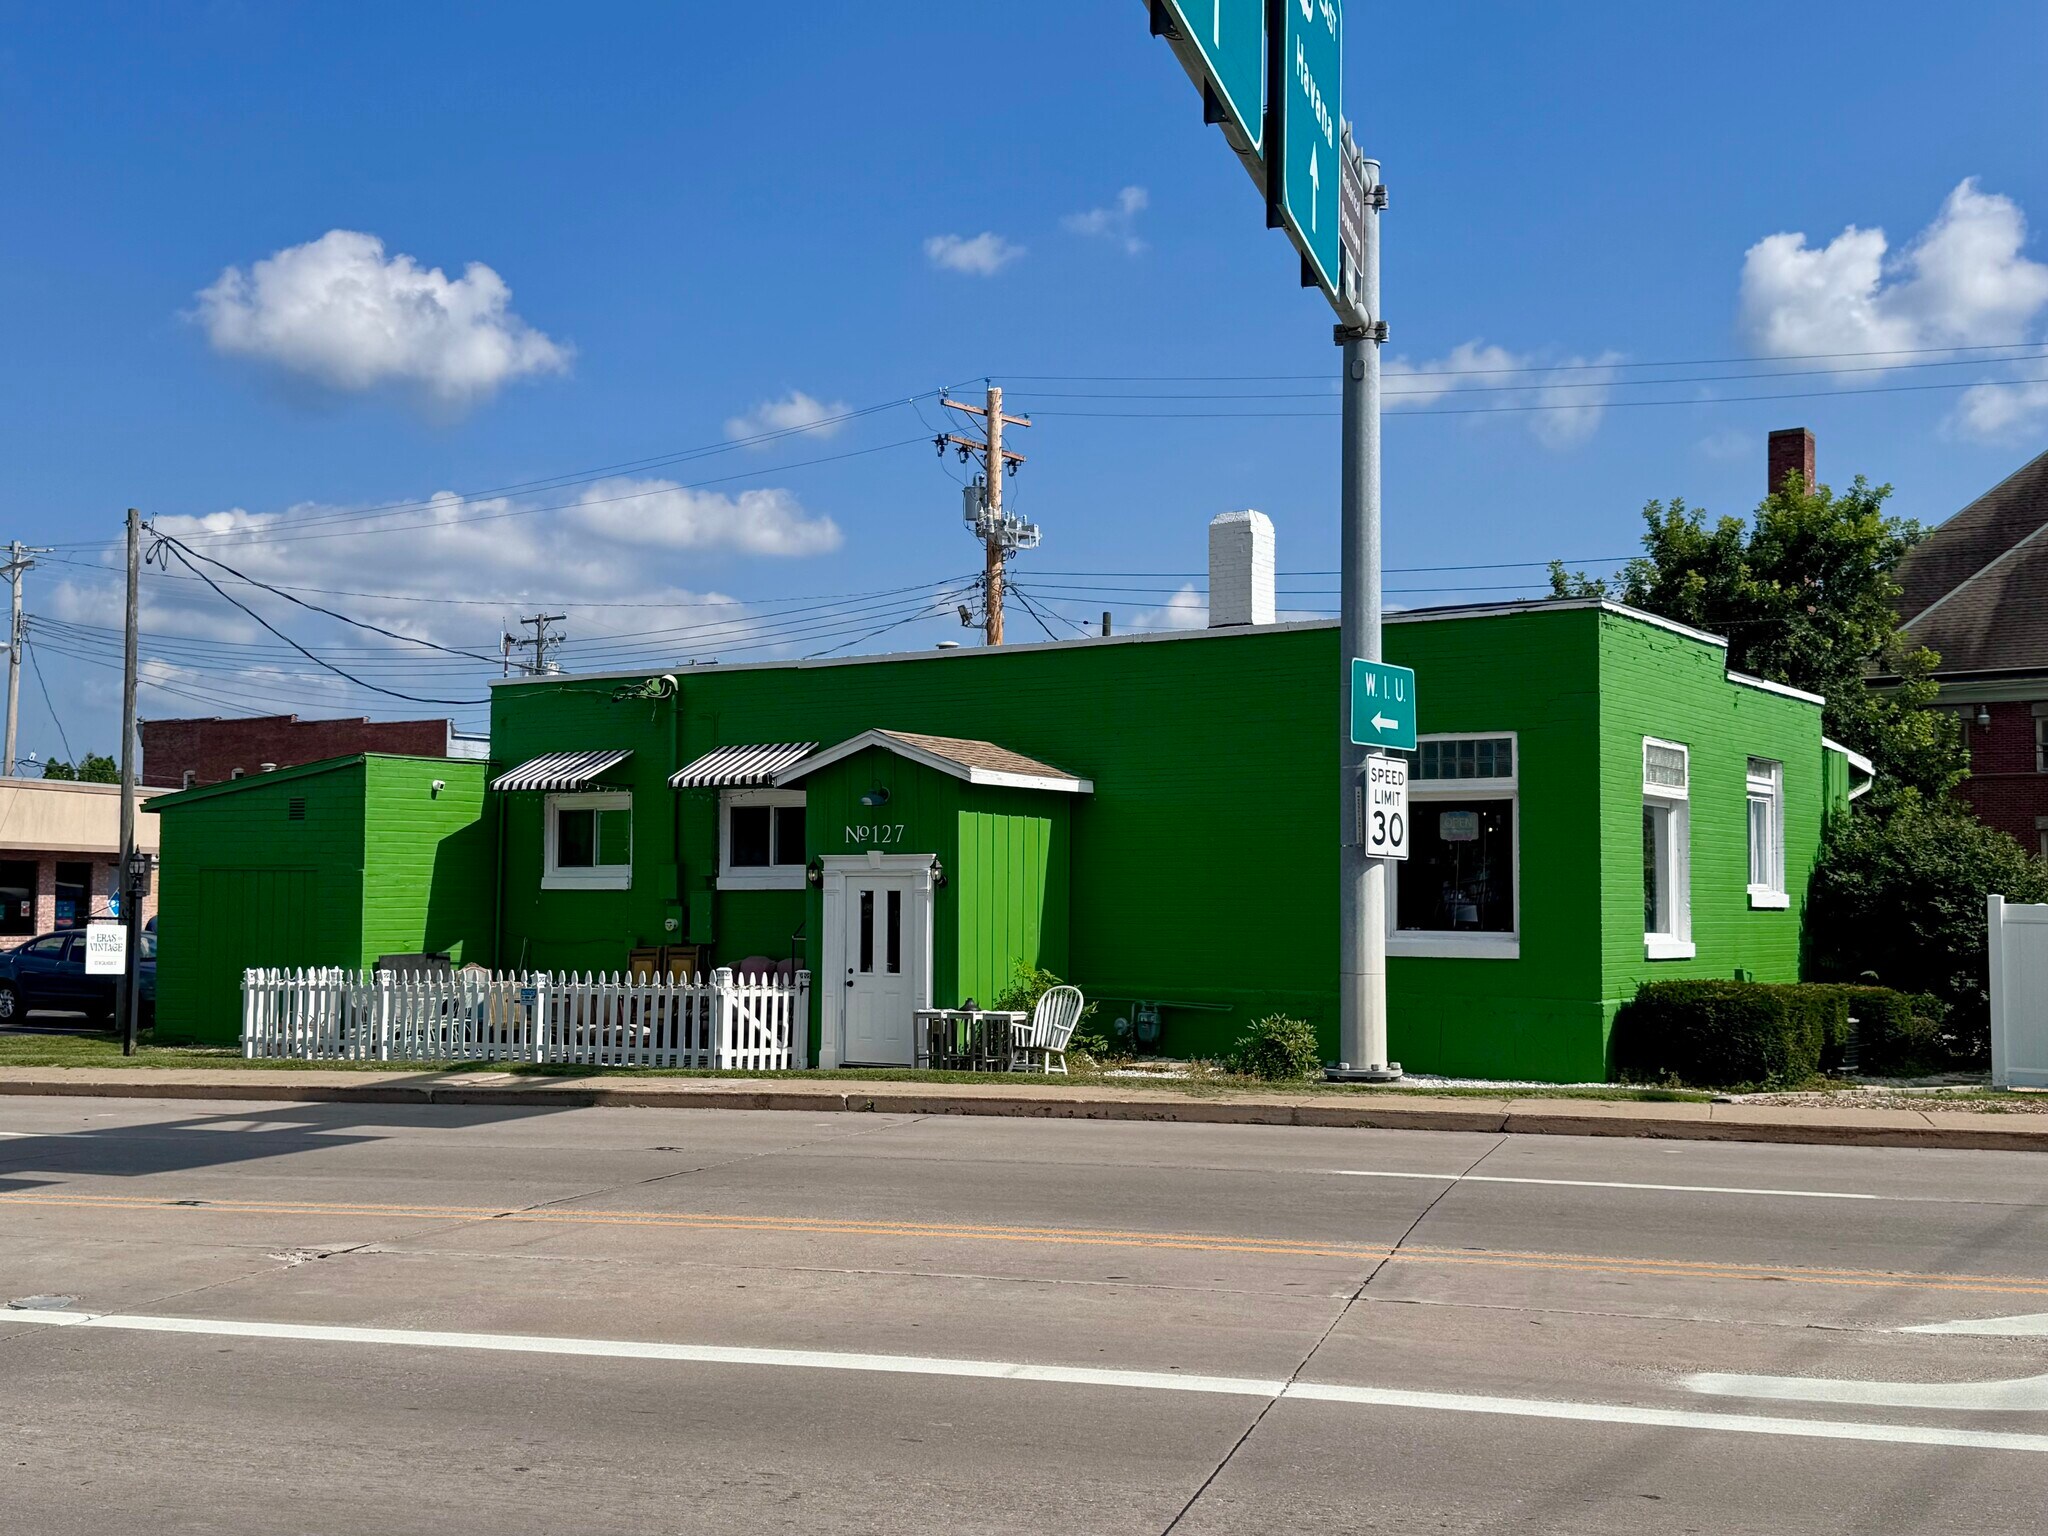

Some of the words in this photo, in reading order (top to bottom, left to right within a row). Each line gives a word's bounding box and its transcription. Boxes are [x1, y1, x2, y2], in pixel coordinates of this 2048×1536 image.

[1296, 34, 1333, 150] Havana
[1370, 767, 1405, 786] SPEED
[1374, 789, 1401, 807] LIMIT
[1371, 810, 1404, 847] 30
[96, 933, 117, 942] ERAS
[90, 943, 123, 952] VINTAGE
